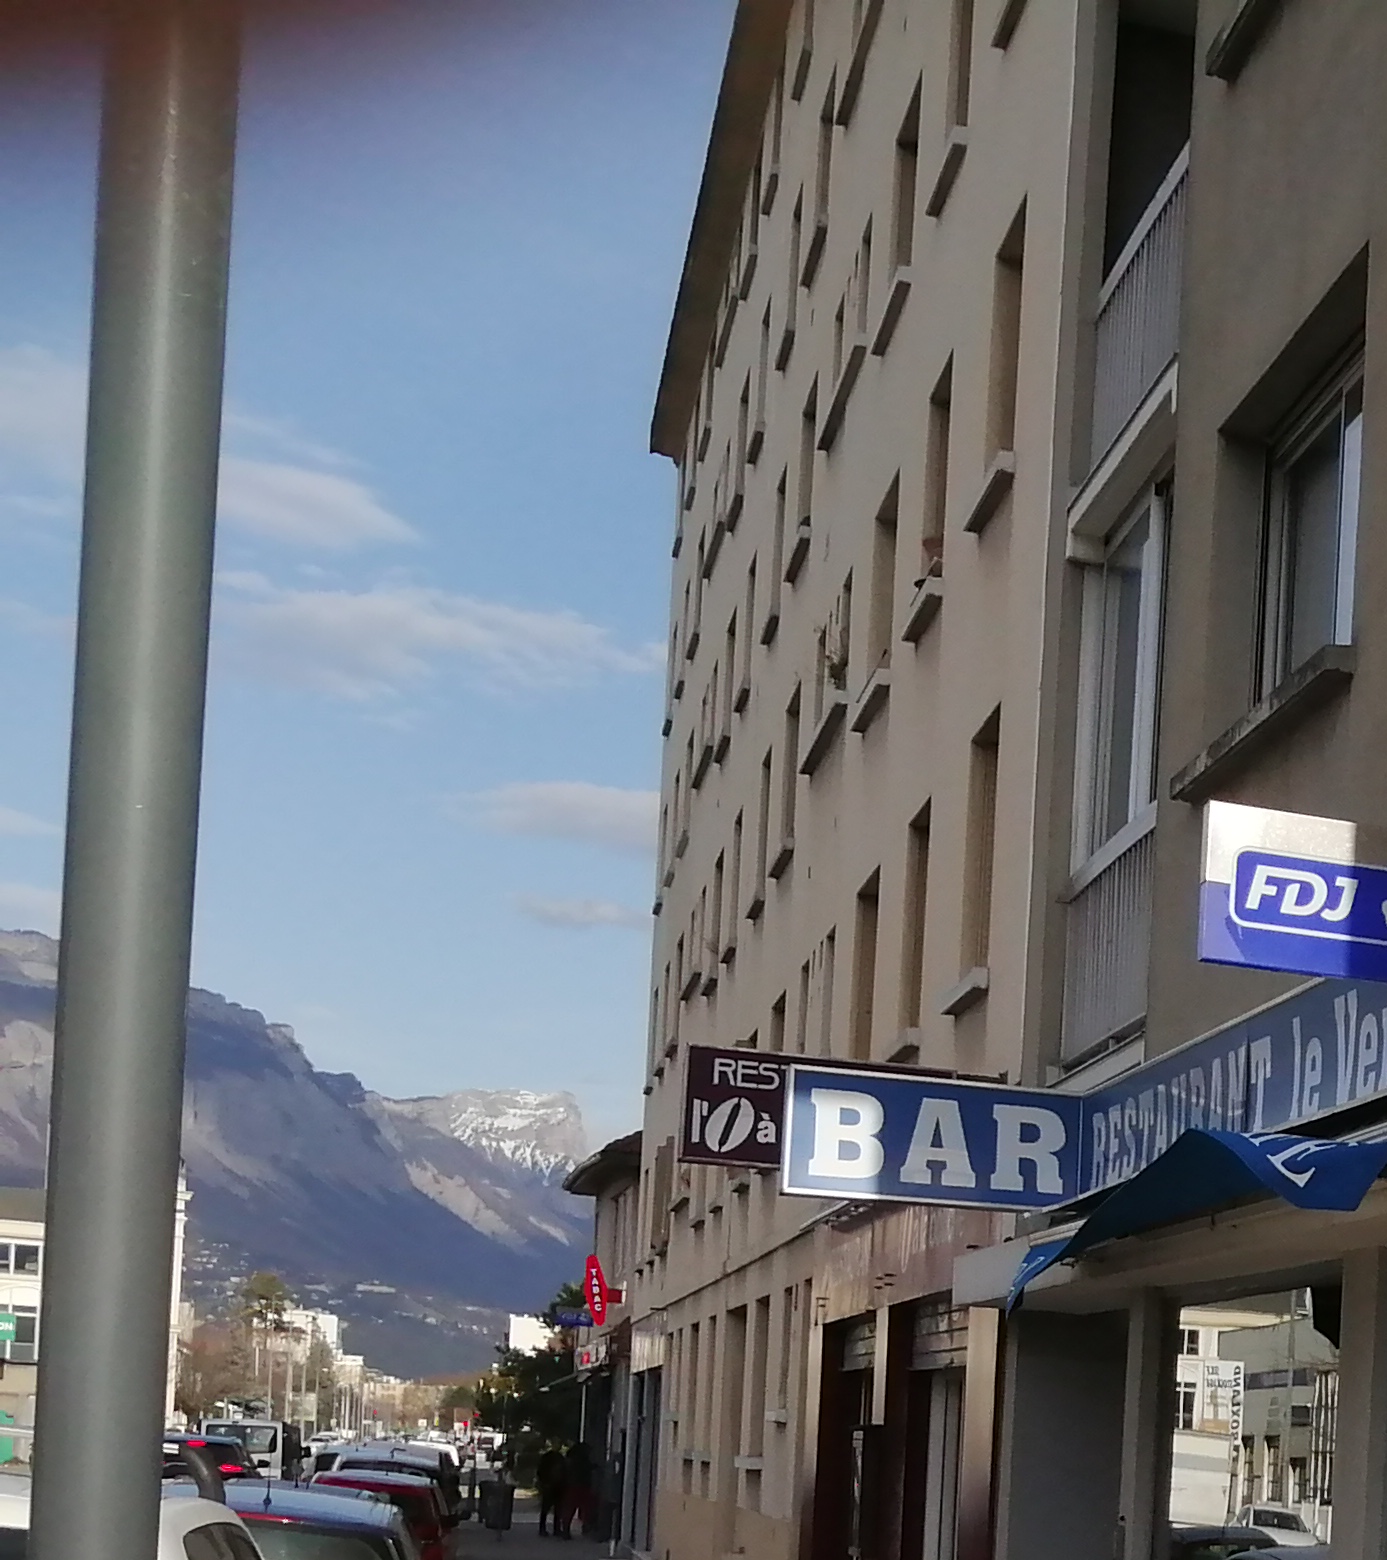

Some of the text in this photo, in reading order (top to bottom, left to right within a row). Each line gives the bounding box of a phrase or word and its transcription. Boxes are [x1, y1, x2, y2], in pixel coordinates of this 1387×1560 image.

[1244, 864, 1359, 922] FDJ
[712, 1057, 787, 1091] RES
[1091, 1035, 1273, 1189] RESTAURANT
[1289, 1016, 1322, 1120] le
[808, 1088, 1067, 1195] BAR
[589, 1268, 603, 1312] TABAC
